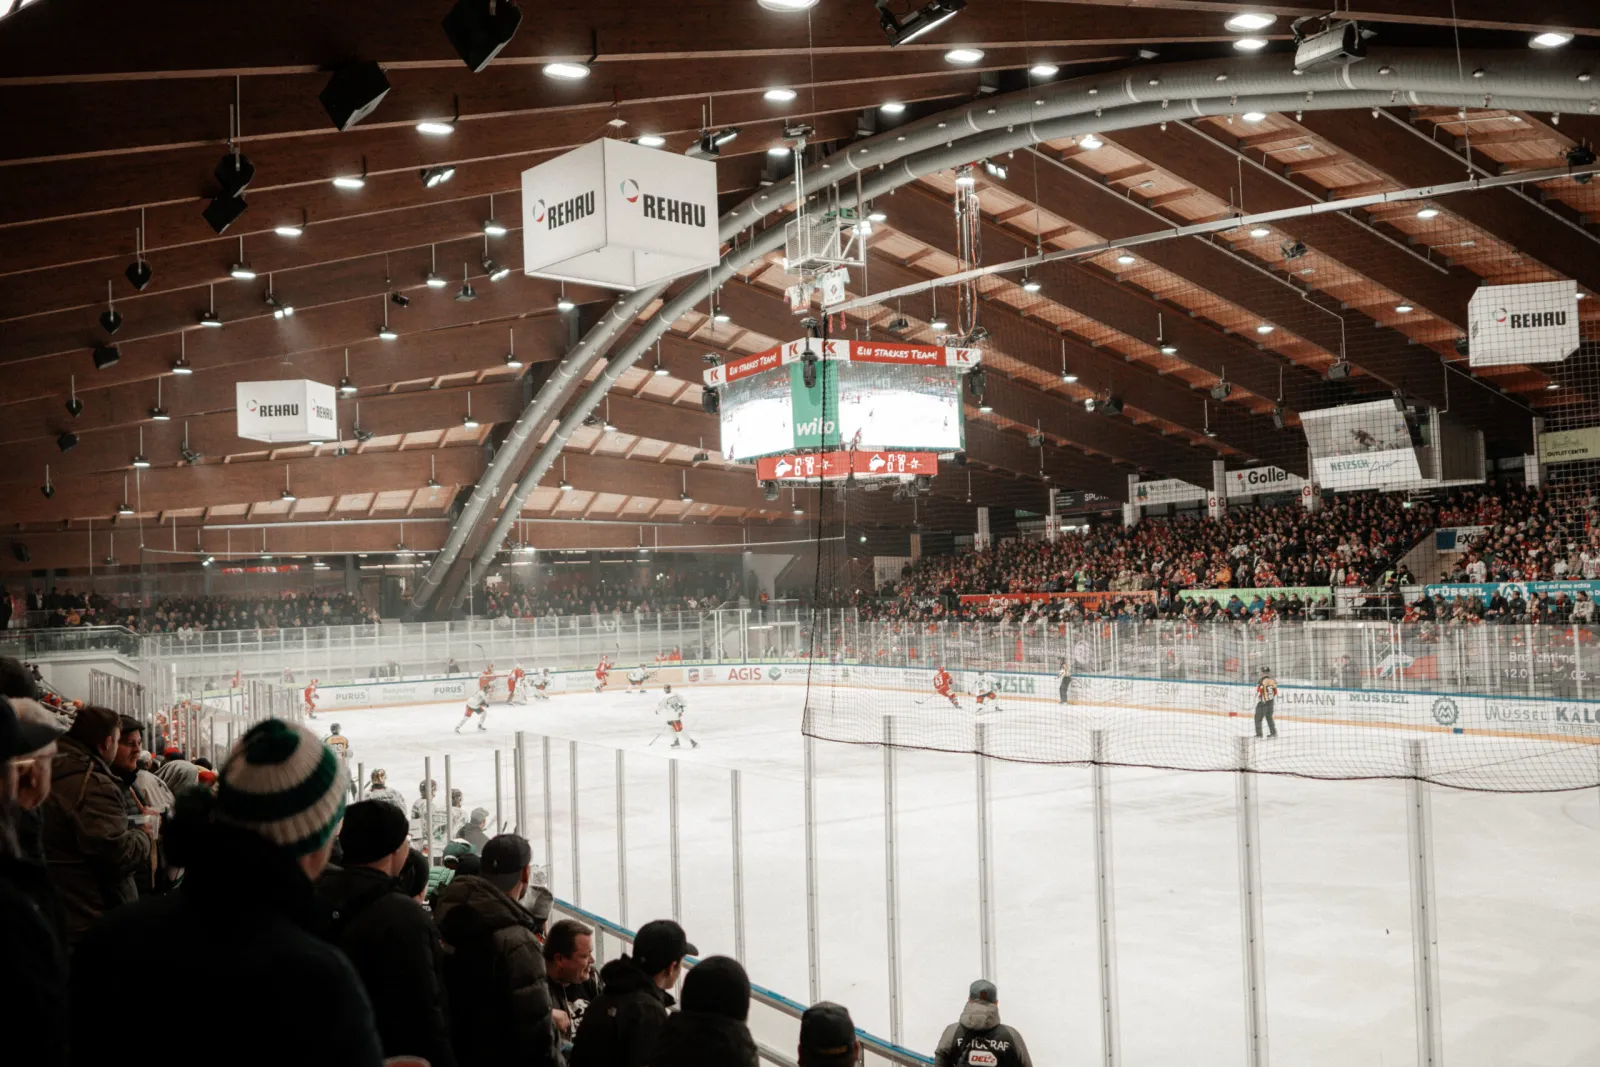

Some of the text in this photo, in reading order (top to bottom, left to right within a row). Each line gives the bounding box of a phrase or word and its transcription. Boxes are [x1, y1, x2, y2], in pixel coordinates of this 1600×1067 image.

[548, 190, 595, 230] REHAU
[643, 193, 706, 227] REHAU
[1511, 311, 1566, 329] REHAU
[260, 404, 299, 417] REHAU
[316, 405, 333, 420] REHAU
[796, 416, 836, 436] wilo
[1330, 459, 1369, 471] NETZSCH
[1248, 468, 1289, 485] Goller
[1428, 585, 1487, 597] MÜSSEL
[1509, 651, 1577, 664] Bruchtime
[728, 667, 762, 681] AGIS
[1504, 668, 1539, 680] 12.0.
[434, 685, 462, 695] PURUS
[1112, 681, 1134, 693] ESM
[1157, 683, 1180, 696] ESM
[1204, 686, 1229, 699] ESM
[336, 692, 366, 701] PURUS
[1276, 692, 1337, 706] HLMANN
[1350, 691, 1409, 704] MÜSSEL
